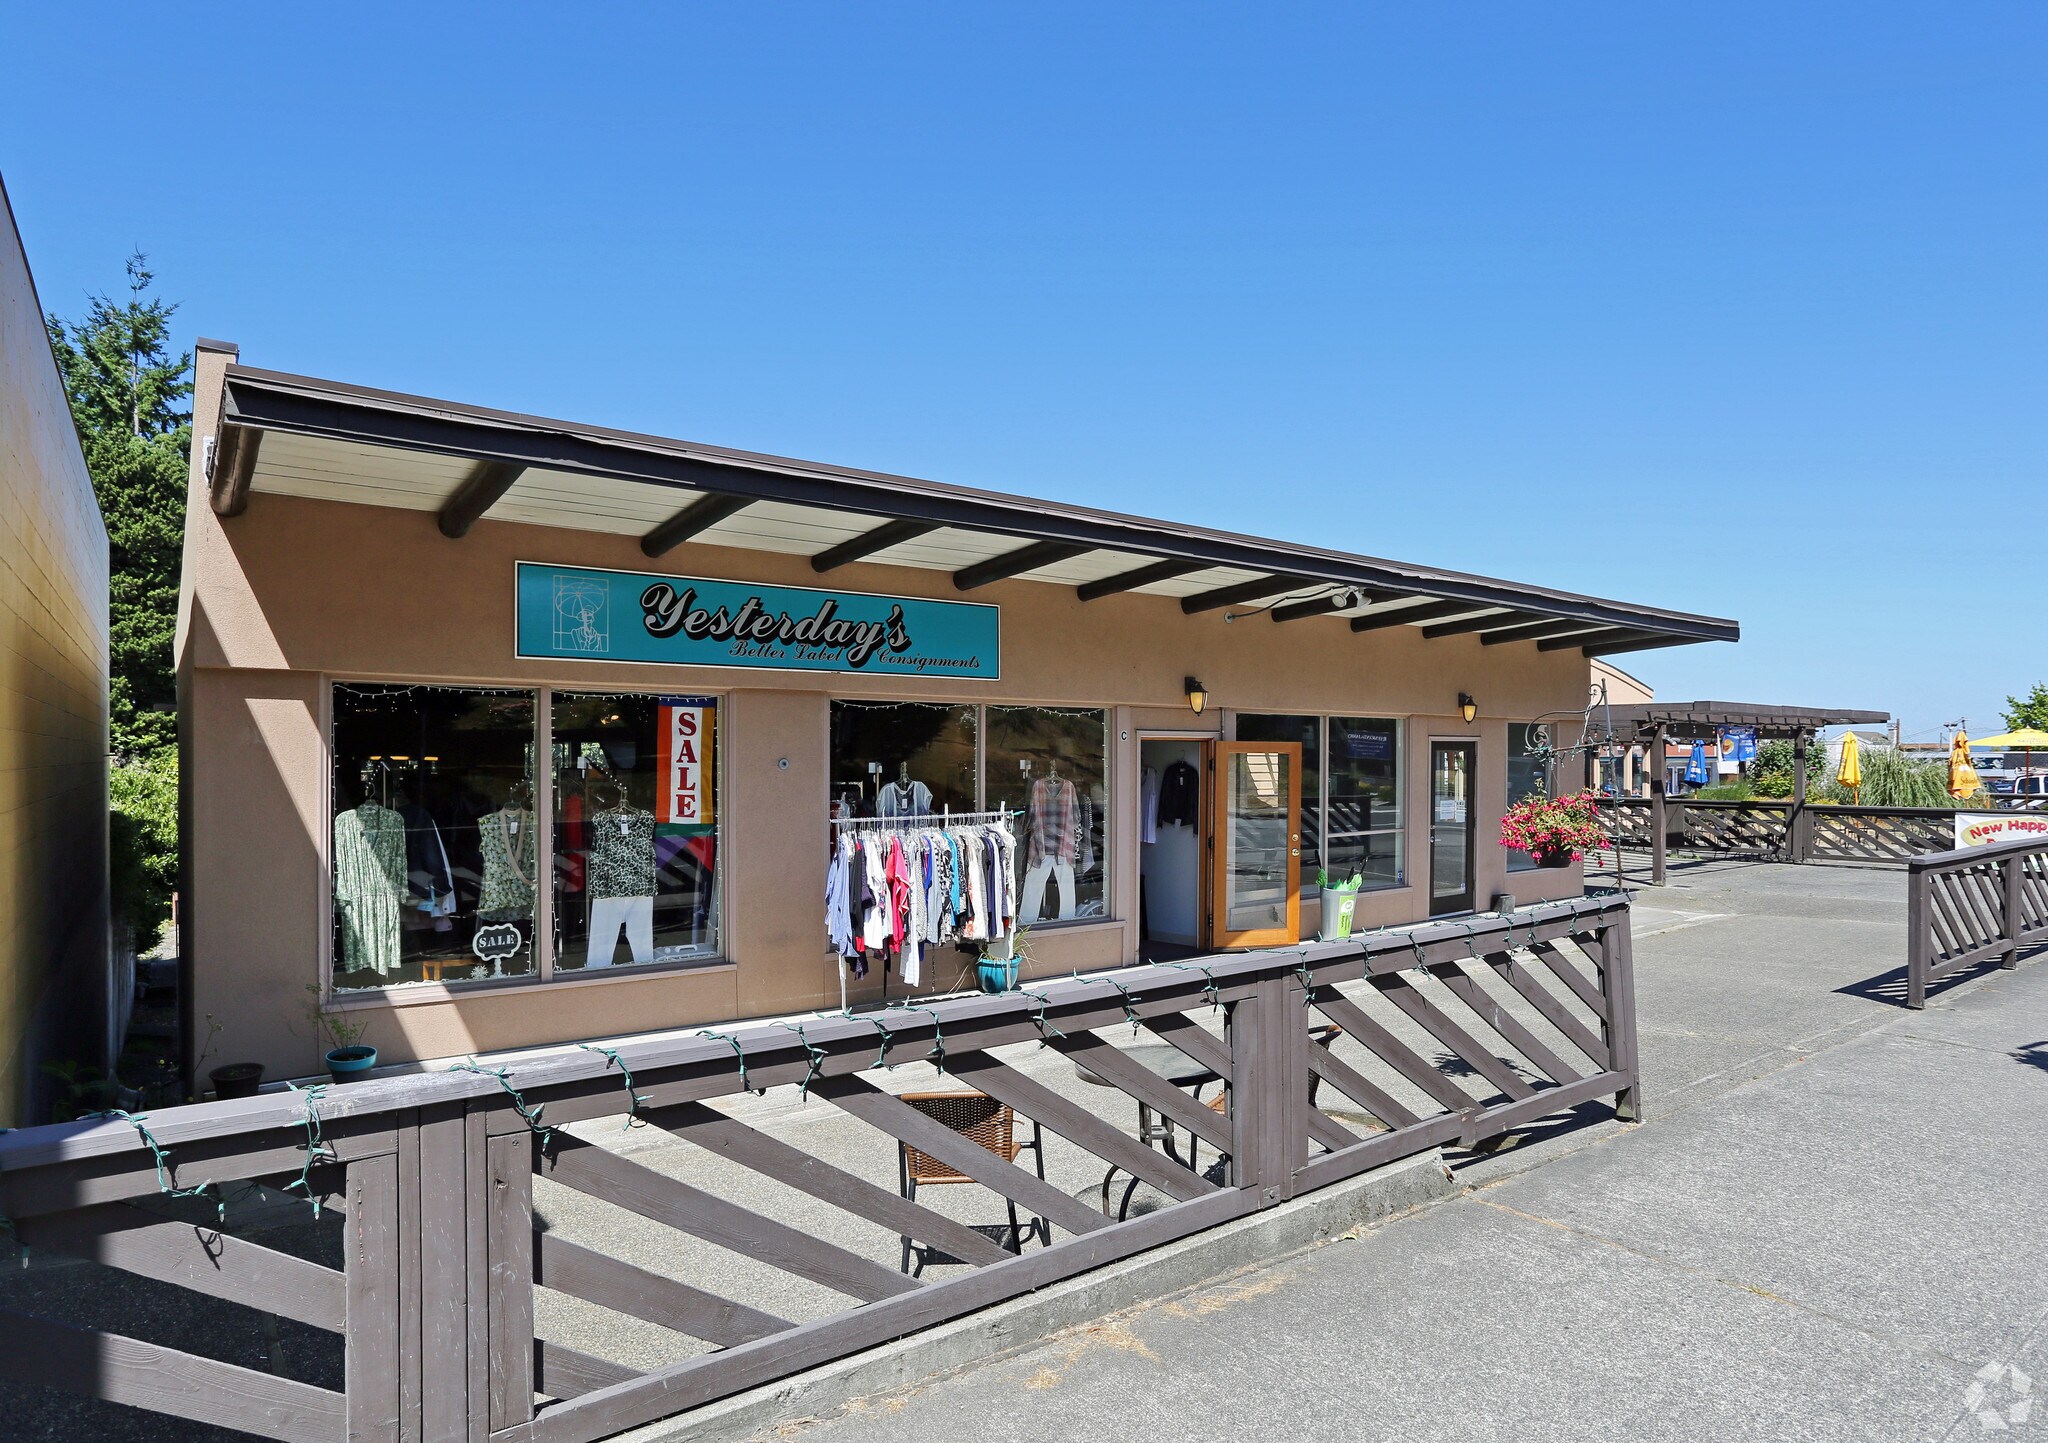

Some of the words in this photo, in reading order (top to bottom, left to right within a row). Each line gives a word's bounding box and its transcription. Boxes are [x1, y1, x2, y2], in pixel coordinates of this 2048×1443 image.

[639, 582, 912, 669] Yesterday's
[729, 639, 786, 660] Better
[793, 642, 846, 662] Label
[876, 647, 980, 671] Consignments
[676, 712, 698, 818] SALE
[1969, 823, 2003, 839] New
[2007, 819, 2048, 833] Happ
[479, 934, 515, 948] SALE
